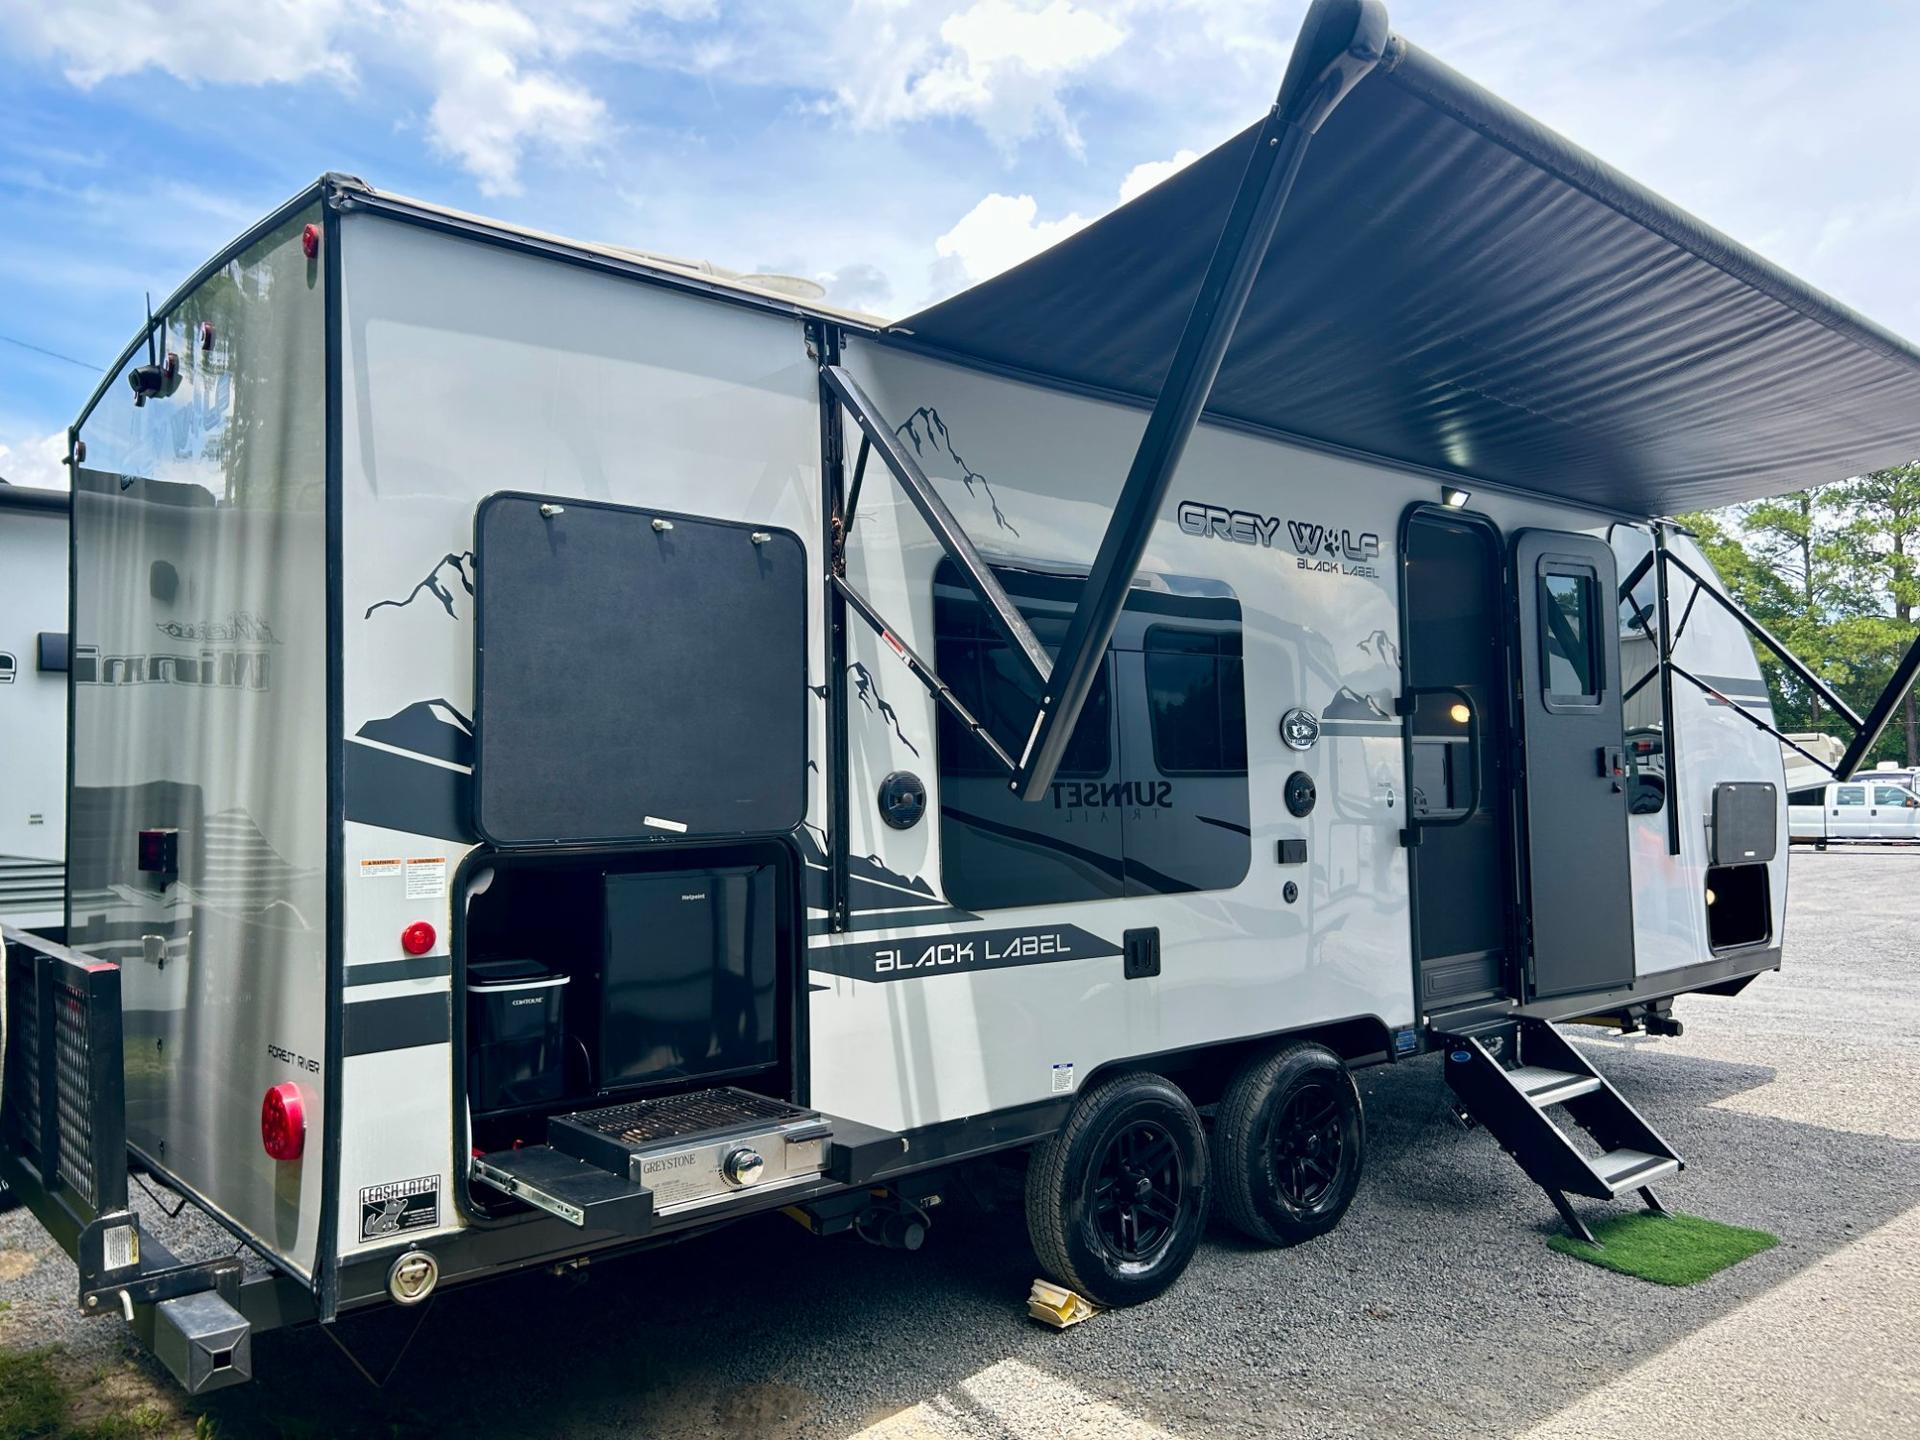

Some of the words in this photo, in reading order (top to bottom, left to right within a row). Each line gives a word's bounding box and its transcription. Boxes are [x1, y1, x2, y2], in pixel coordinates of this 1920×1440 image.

[1177, 500, 1280, 548] GREY
[1297, 558, 1339, 574] BLACK
[1342, 564, 1380, 579] LABEL
[875, 942, 975, 973] BLACK
[985, 934, 1071, 960] LABEL
[268, 1044, 296, 1065] FOREST
[297, 1055, 320, 1075] RIVER
[643, 1153, 697, 1175] GREYSTONE
